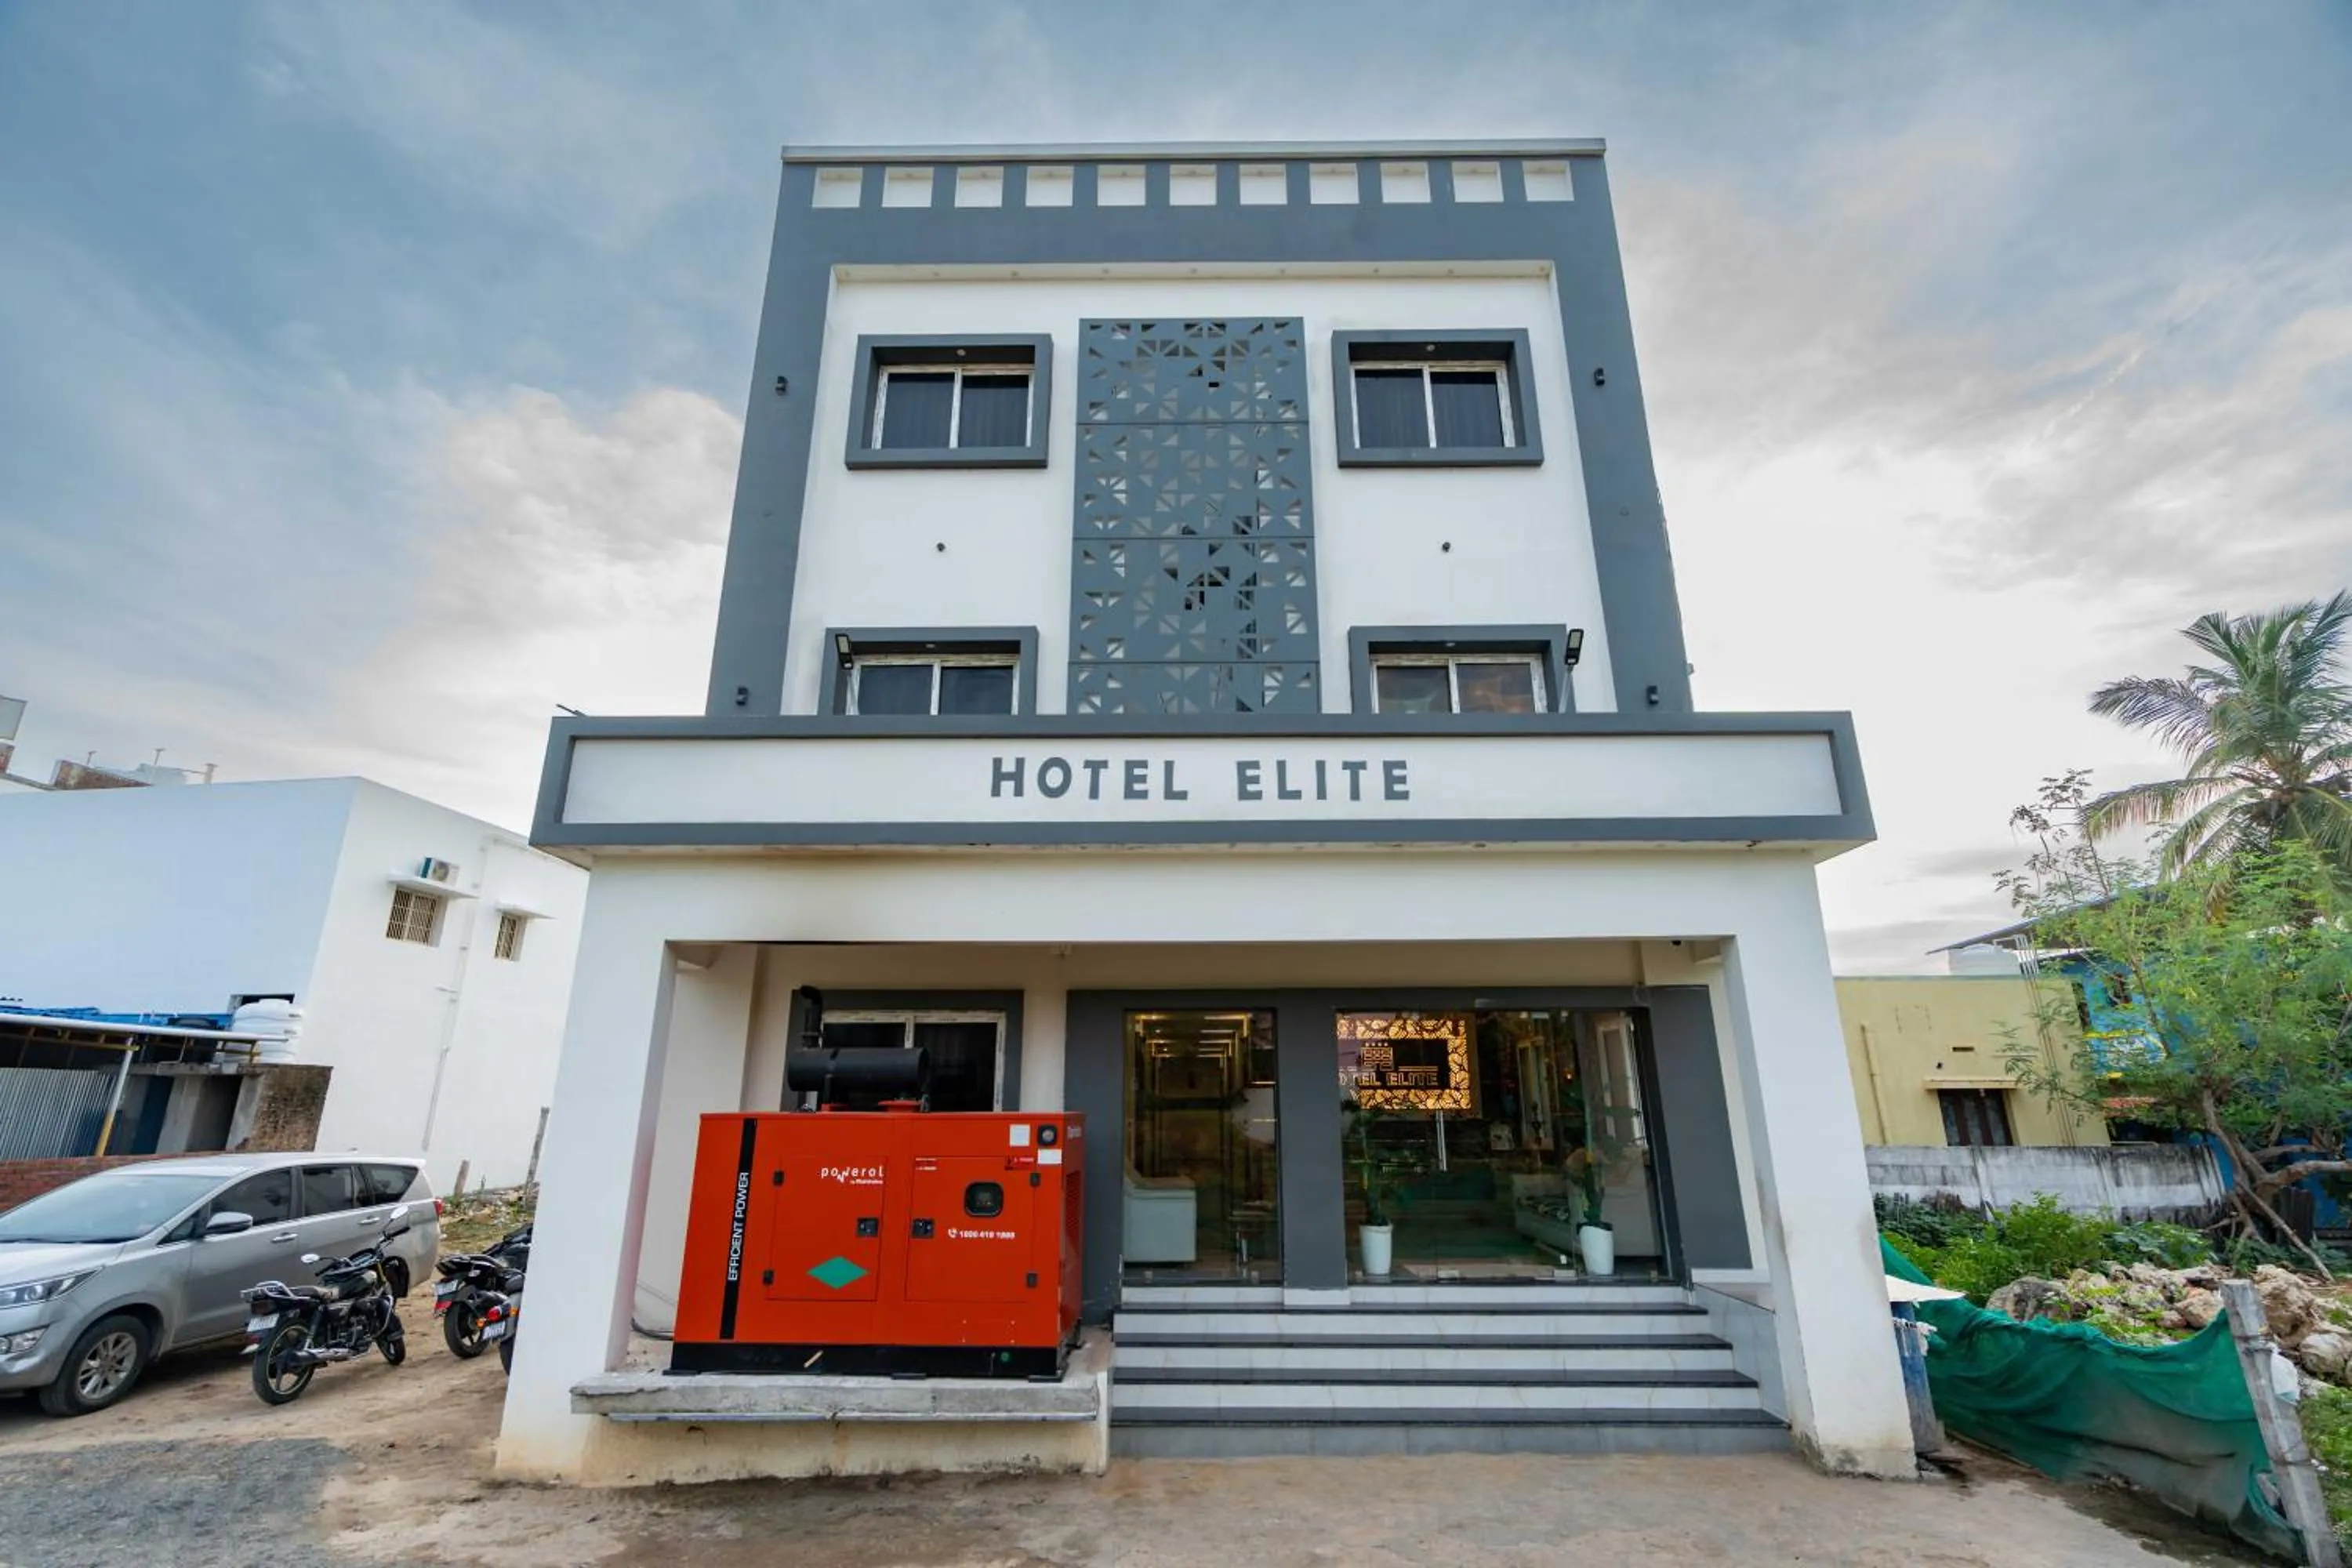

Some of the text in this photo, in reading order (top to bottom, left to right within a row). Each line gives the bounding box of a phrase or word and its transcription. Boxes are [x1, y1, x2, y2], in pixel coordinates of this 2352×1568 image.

[990, 757, 1410, 800] HOTEL ELITE
[1338, 1072, 1439, 1086] OTEL ELITE
[728, 1172, 749, 1280] EFFICIENT POWER
